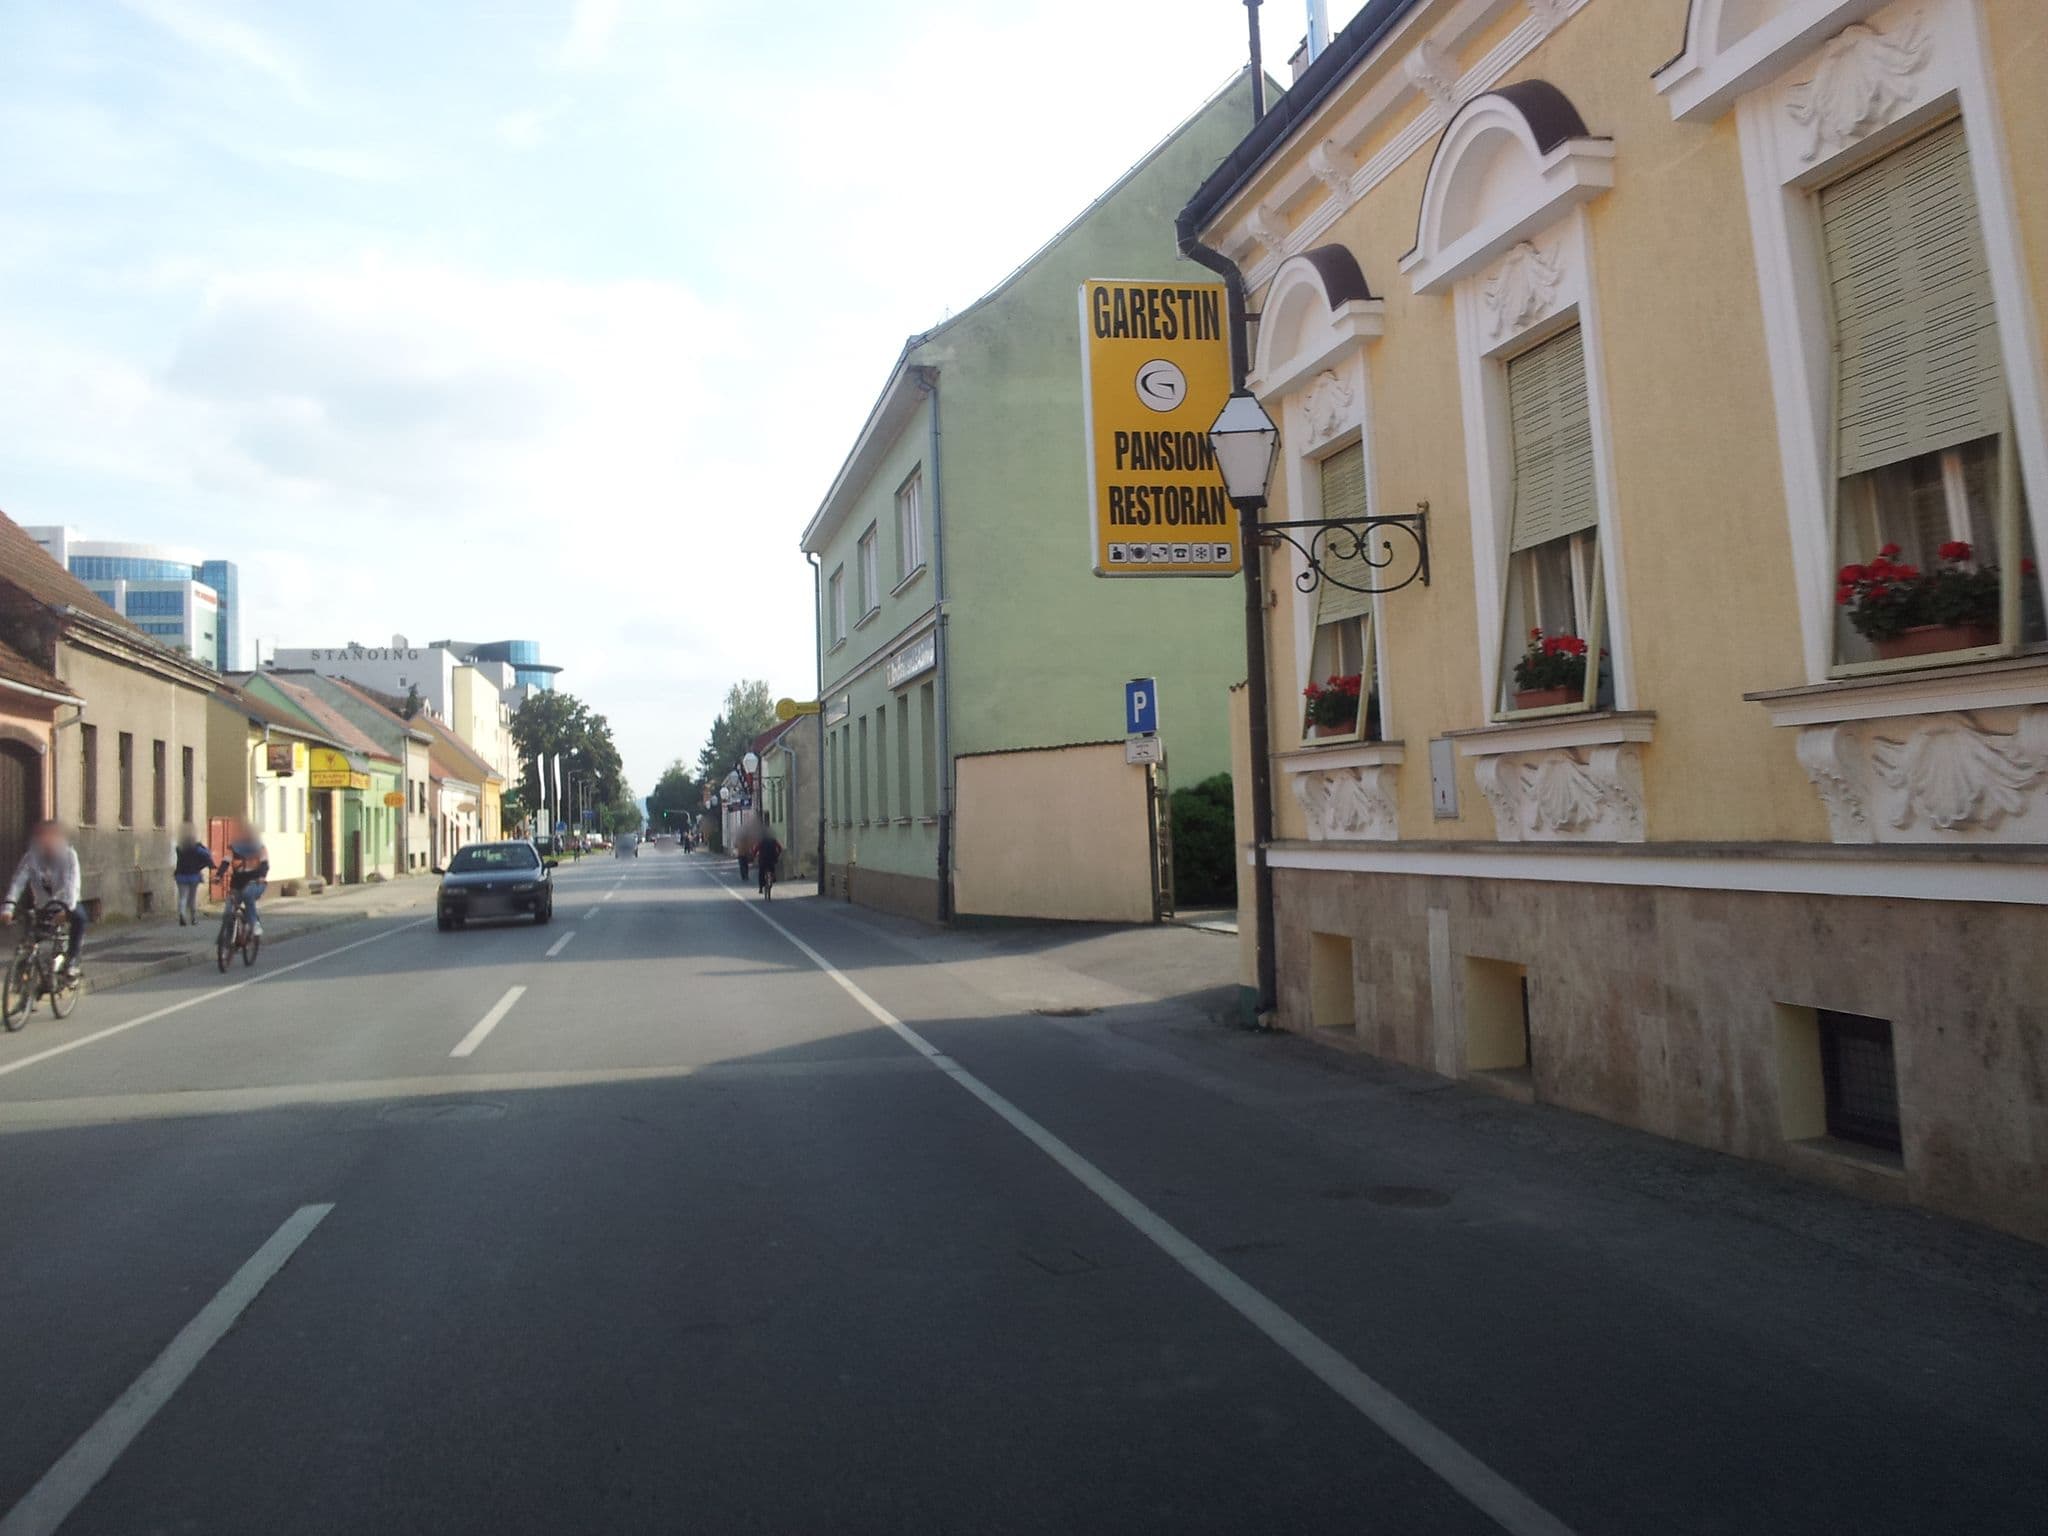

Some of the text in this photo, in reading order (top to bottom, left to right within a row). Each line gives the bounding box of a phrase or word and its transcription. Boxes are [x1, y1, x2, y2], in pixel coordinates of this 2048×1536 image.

[1093, 286, 1220, 340] GARESTIN
[1114, 431, 1214, 471] PANSION
[1108, 485, 1226, 526] RESTORAN
[1216, 547, 1227, 559] P
[1133, 690, 1147, 723] P
